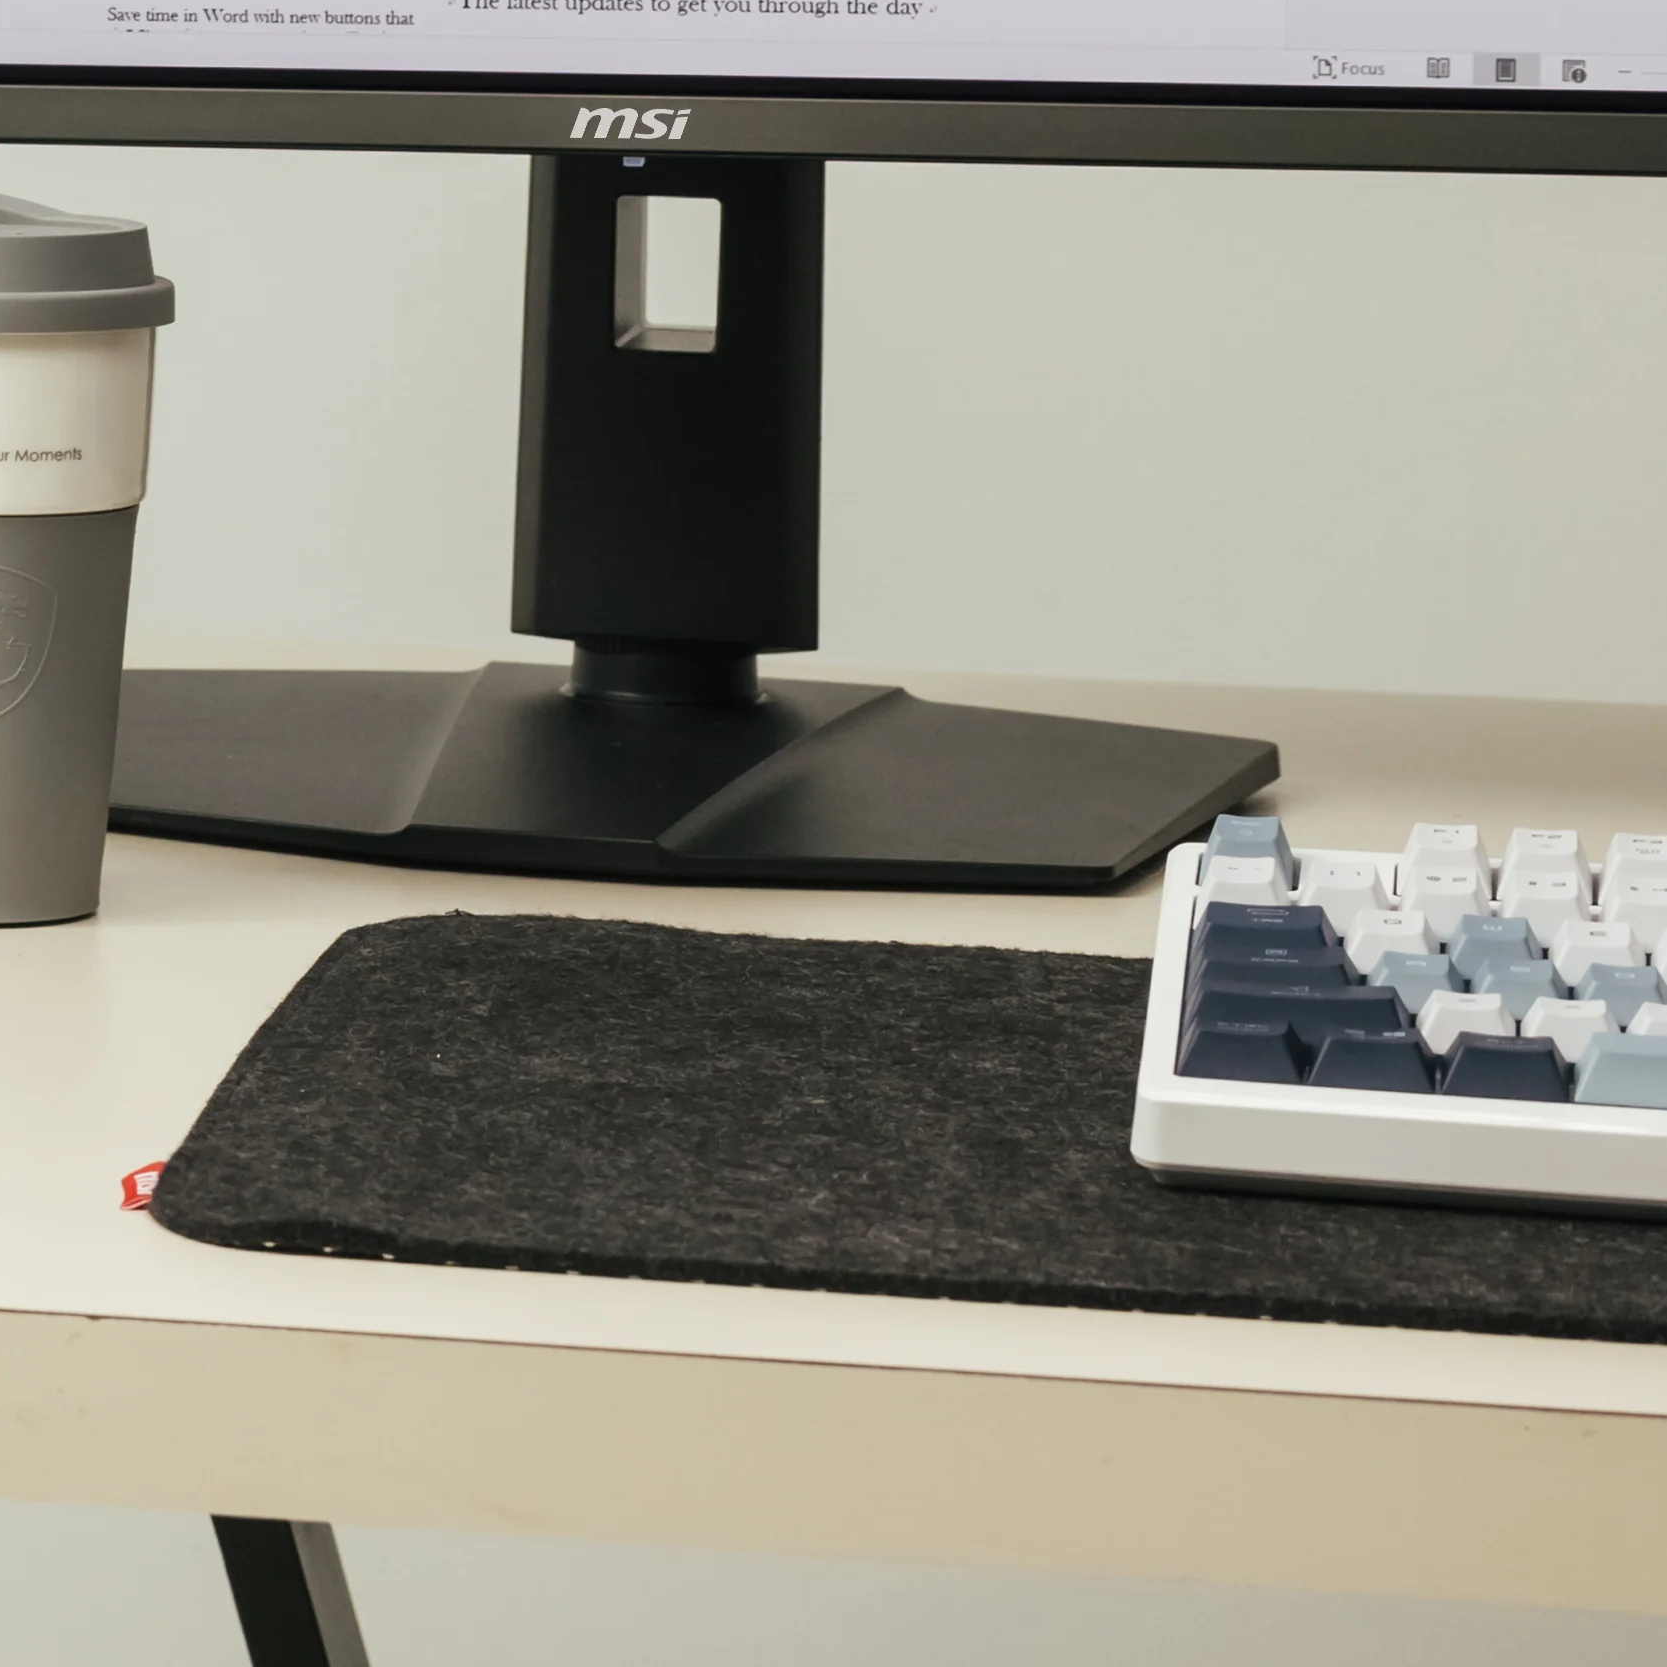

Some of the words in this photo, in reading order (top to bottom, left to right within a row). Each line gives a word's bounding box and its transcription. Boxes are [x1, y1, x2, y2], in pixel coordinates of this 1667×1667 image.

[678, 0, 707, 17] get
[714, 0, 751, 17] you
[1341, 61, 1386, 76] Focus
[569, 107, 692, 140] msi
[15, 448, 82, 463] Moments
